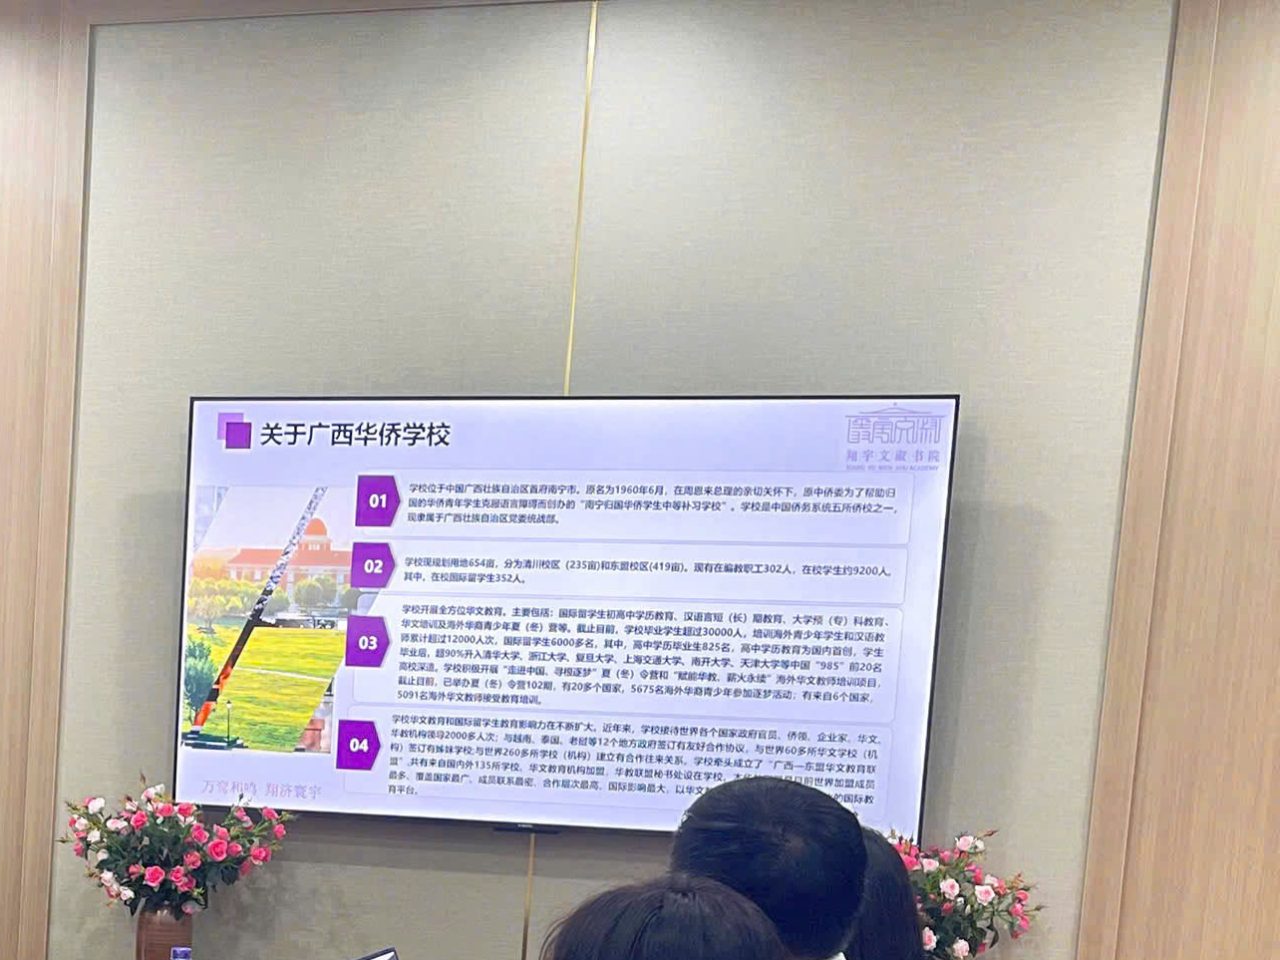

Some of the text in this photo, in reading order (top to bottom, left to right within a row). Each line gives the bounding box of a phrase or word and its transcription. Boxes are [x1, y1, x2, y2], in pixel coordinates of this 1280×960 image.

[260, 421, 452, 447] 关于广西华侨学校
[368, 493, 388, 508] 01
[363, 558, 383, 574] 02
[358, 635, 378, 650] 03
[349, 738, 369, 753] 04
[388, 785, 418, 794] 育平台。
